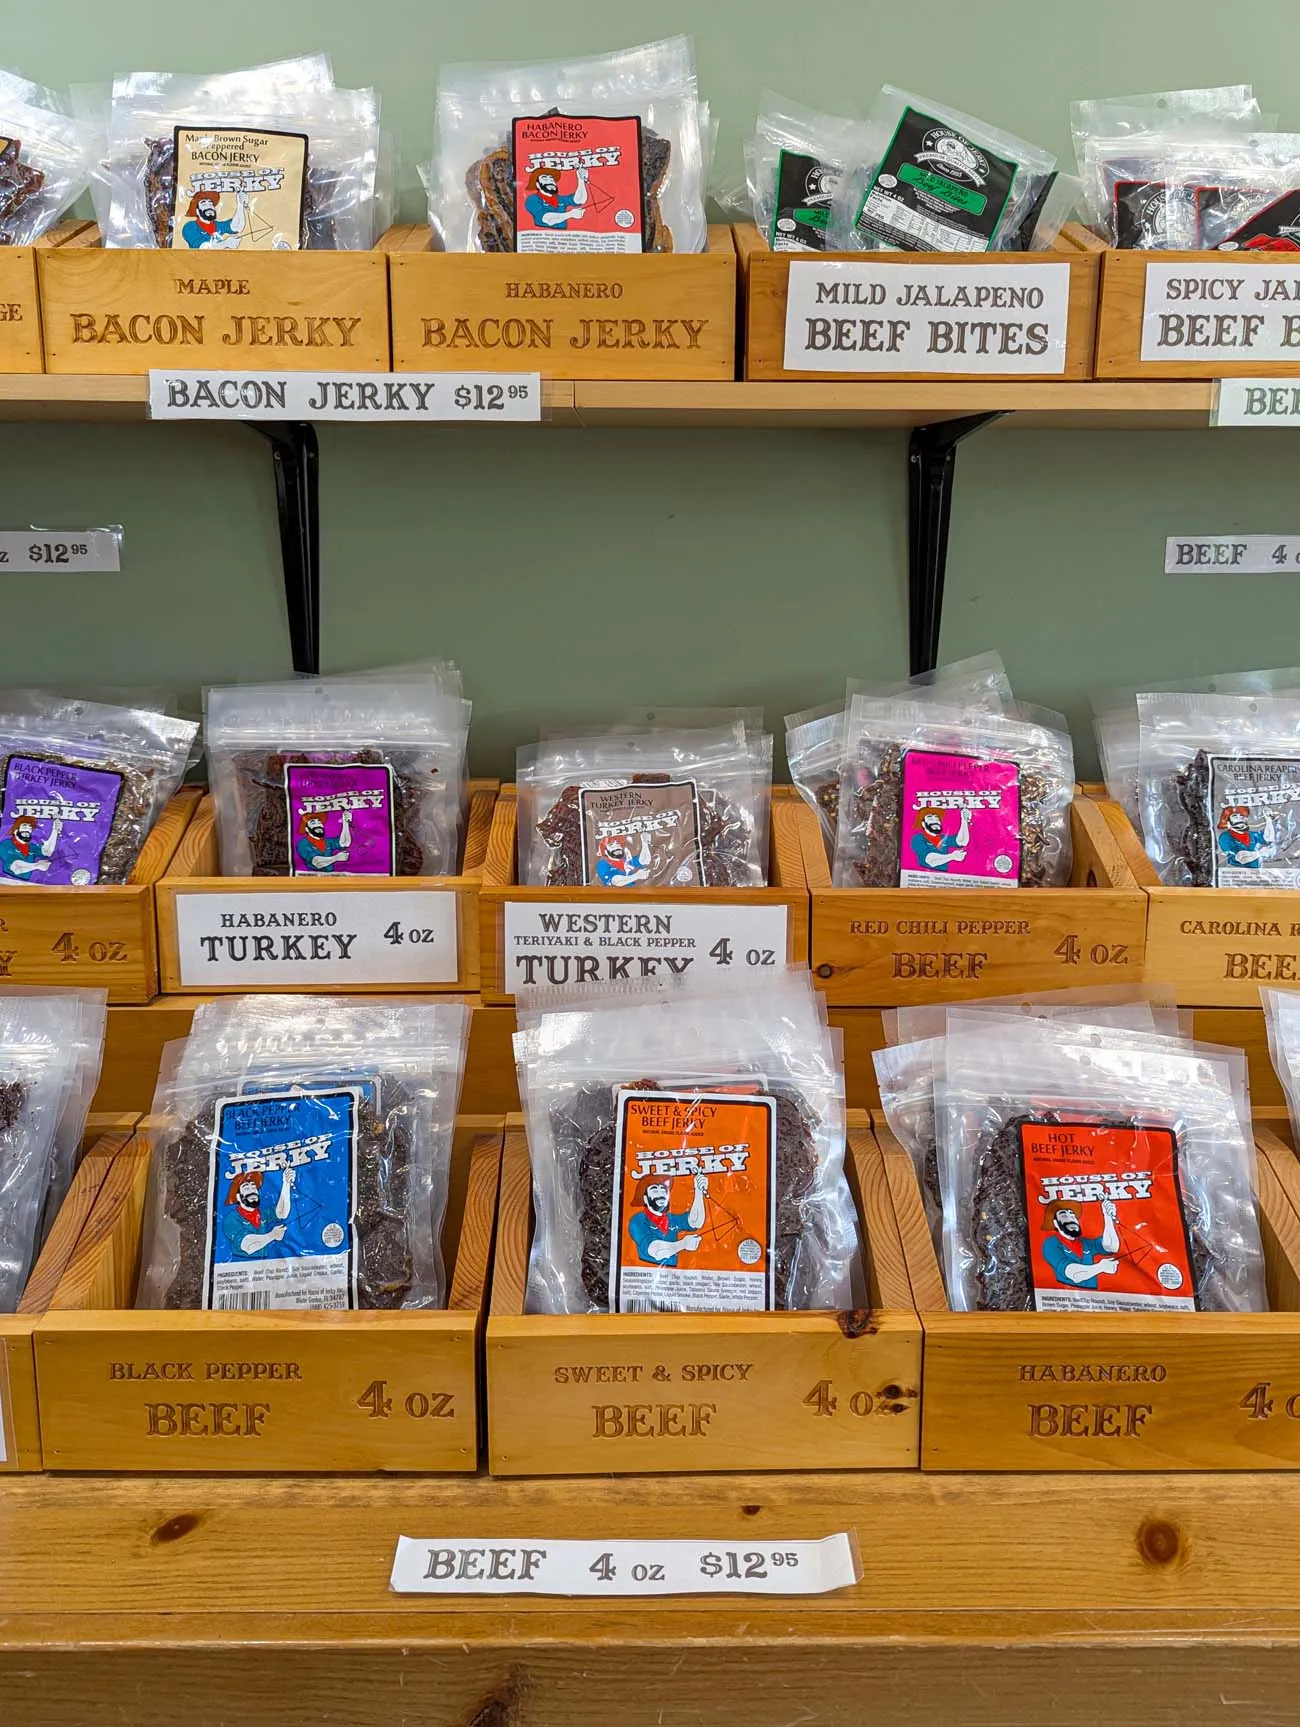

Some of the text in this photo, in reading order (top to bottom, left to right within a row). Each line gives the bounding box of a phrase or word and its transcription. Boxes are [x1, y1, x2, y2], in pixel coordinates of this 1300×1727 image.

[521, 129, 589, 140] BACON JERKY
[527, 122, 582, 131] HABANERO
[206, 142, 244, 151] eppered
[243, 135, 268, 146] Sugar
[191, 152, 260, 163] BACON JERKY
[524, 151, 622, 173] JERKY
[527, 148, 593, 159] HOUSE
[186, 174, 285, 197] JERKY
[175, 278, 251, 296] MAPLE
[505, 282, 623, 299] HABANERO
[814, 281, 1045, 309] MILD JALAPENO
[1166, 278, 1245, 300] SPICY
[72, 312, 362, 349] BACON JERKY
[421, 318, 709, 351] BACON JERKY
[804, 317, 1050, 356] BEEF BITES
[1156, 313, 1265, 347] BEEF
[166, 379, 288, 410] BACON
[308, 380, 436, 412] JERKY
[1175, 543, 1248, 565] BEEF
[1271, 544, 1288, 565] 4
[14, 763, 47, 776] BLACK
[1217, 764, 1263, 773] CAROLINA
[15, 798, 73, 807] HOUSE
[298, 794, 385, 815] JERKY
[301, 788, 384, 802] HOUSE OF
[591, 799, 625, 809] TURKEY
[628, 799, 653, 808] JERKY
[600, 791, 642, 802] WESTERN
[912, 796, 1002, 810] JERKY
[10, 805, 101, 822] JERKY
[595, 815, 679, 839] JERKY
[220, 912, 337, 928] HABANERO
[538, 913, 672, 934] WESTERN
[849, 919, 1031, 935] RED CHILI PEPPER
[1180, 920, 1282, 937] CAROLINA
[51, 931, 79, 963] 4
[88, 941, 128, 962] oz
[200, 921, 435, 962] TURKEY 4 oz
[513, 935, 697, 948] TERIYAKI & BLACK PEPPER
[708, 937, 733, 966] 4
[745, 948, 776, 966] oz
[890, 935, 1129, 980] BEEF 4 oz
[1223, 953, 1300, 981] BEE
[630, 1104, 718, 1118] SWEET & SPICY
[641, 1116, 706, 1130] BEEF JERKY
[228, 1133, 333, 1161] HOUSE OF
[1048, 1133, 1076, 1143] HOT
[636, 1143, 749, 1160] HOUSE OF
[1031, 1143, 1096, 1157] BEEF JERKY
[225, 1140, 333, 1180] JERKY
[630, 1151, 750, 1180] JERKY
[1040, 1171, 1153, 1186] HOUSE OF
[1038, 1179, 1153, 1205] JERKY
[108, 1362, 302, 1381] BLACK PEPPER
[554, 1364, 753, 1384] SWEET & SPICY
[1018, 1364, 1167, 1382] HABANERO
[144, 1380, 456, 1438] BEEF 4 oz
[591, 1403, 717, 1439] BEEF
[801, 1379, 837, 1417] 4
[1027, 1403, 1153, 1439] BEEF
[1239, 1382, 1274, 1419] 4
[423, 1548, 548, 1580] BEEF
[589, 1552, 617, 1581] 4
[631, 1563, 666, 1582] oz
